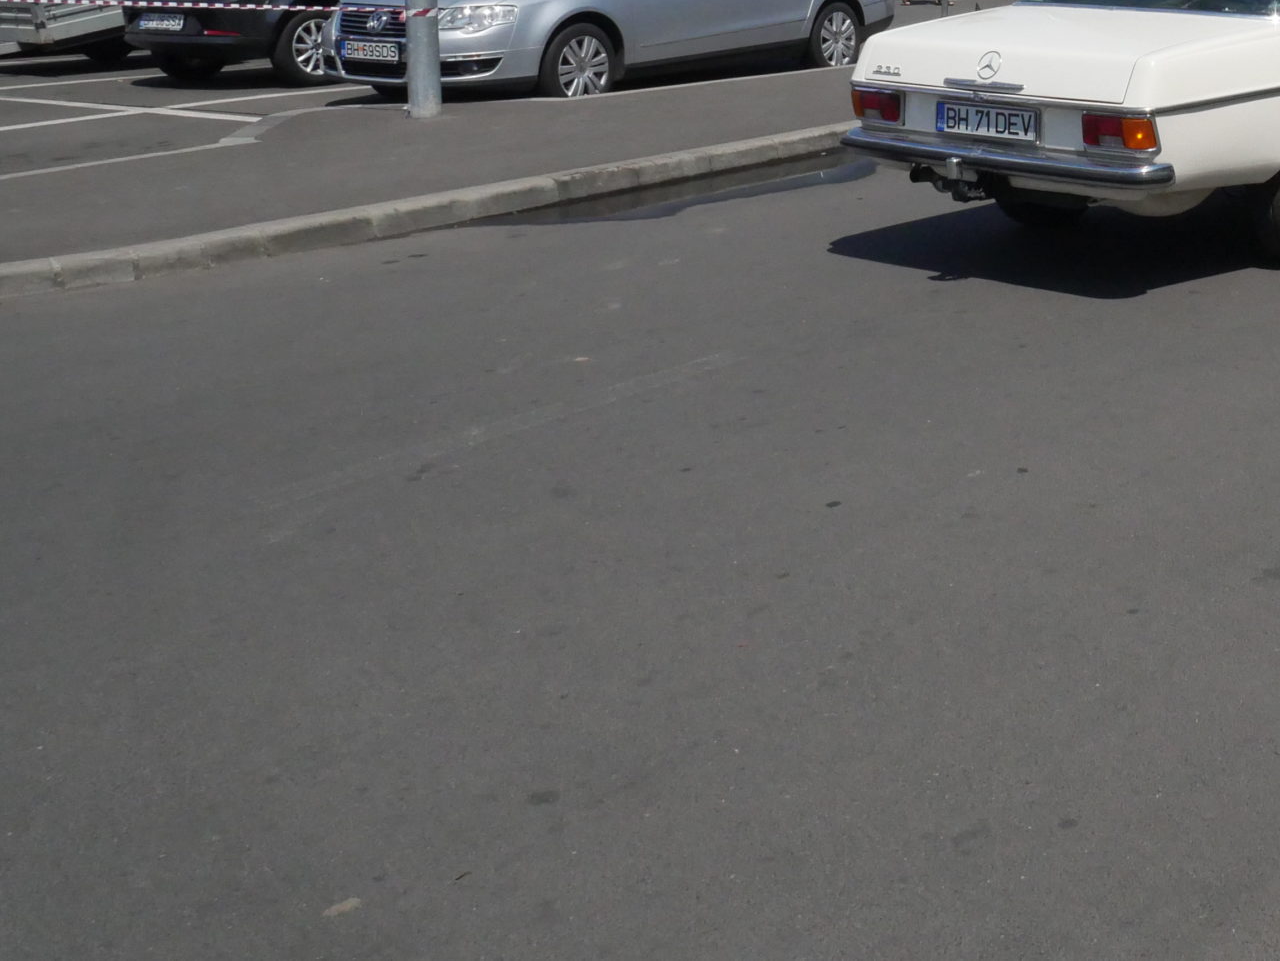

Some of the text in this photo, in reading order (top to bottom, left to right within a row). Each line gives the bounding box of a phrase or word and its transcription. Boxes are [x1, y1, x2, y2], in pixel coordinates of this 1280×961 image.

[346, 42, 360, 56] BH
[946, 107, 1032, 136] BH 71 DEV
